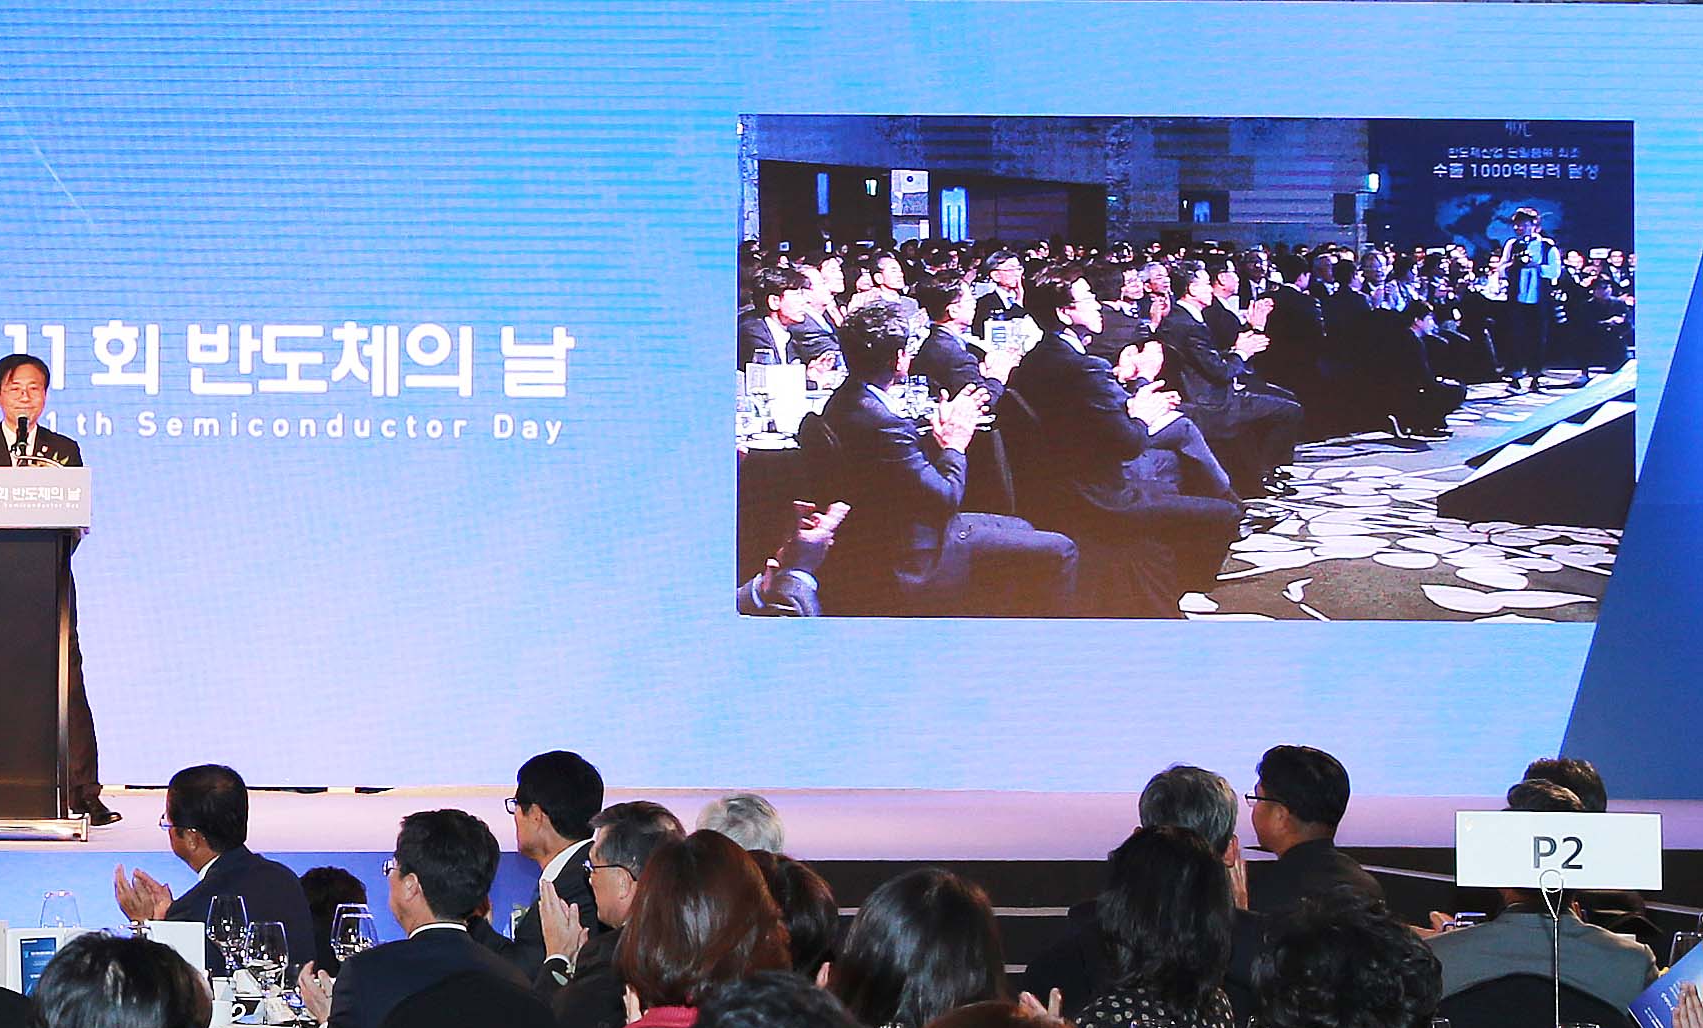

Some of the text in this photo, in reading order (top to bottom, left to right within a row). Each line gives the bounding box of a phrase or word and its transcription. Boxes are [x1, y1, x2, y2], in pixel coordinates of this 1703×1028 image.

[1433, 163, 1464, 178] 수출
[1470, 163, 1561, 178] 1000억달러
[91, 320, 160, 395] 회
[187, 321, 474, 398] 반도체의
[500, 326, 576, 398] 날
[138, 411, 467, 438] Semiconductor
[493, 414, 563, 445] Day
[1533, 836, 1583, 869] P2
